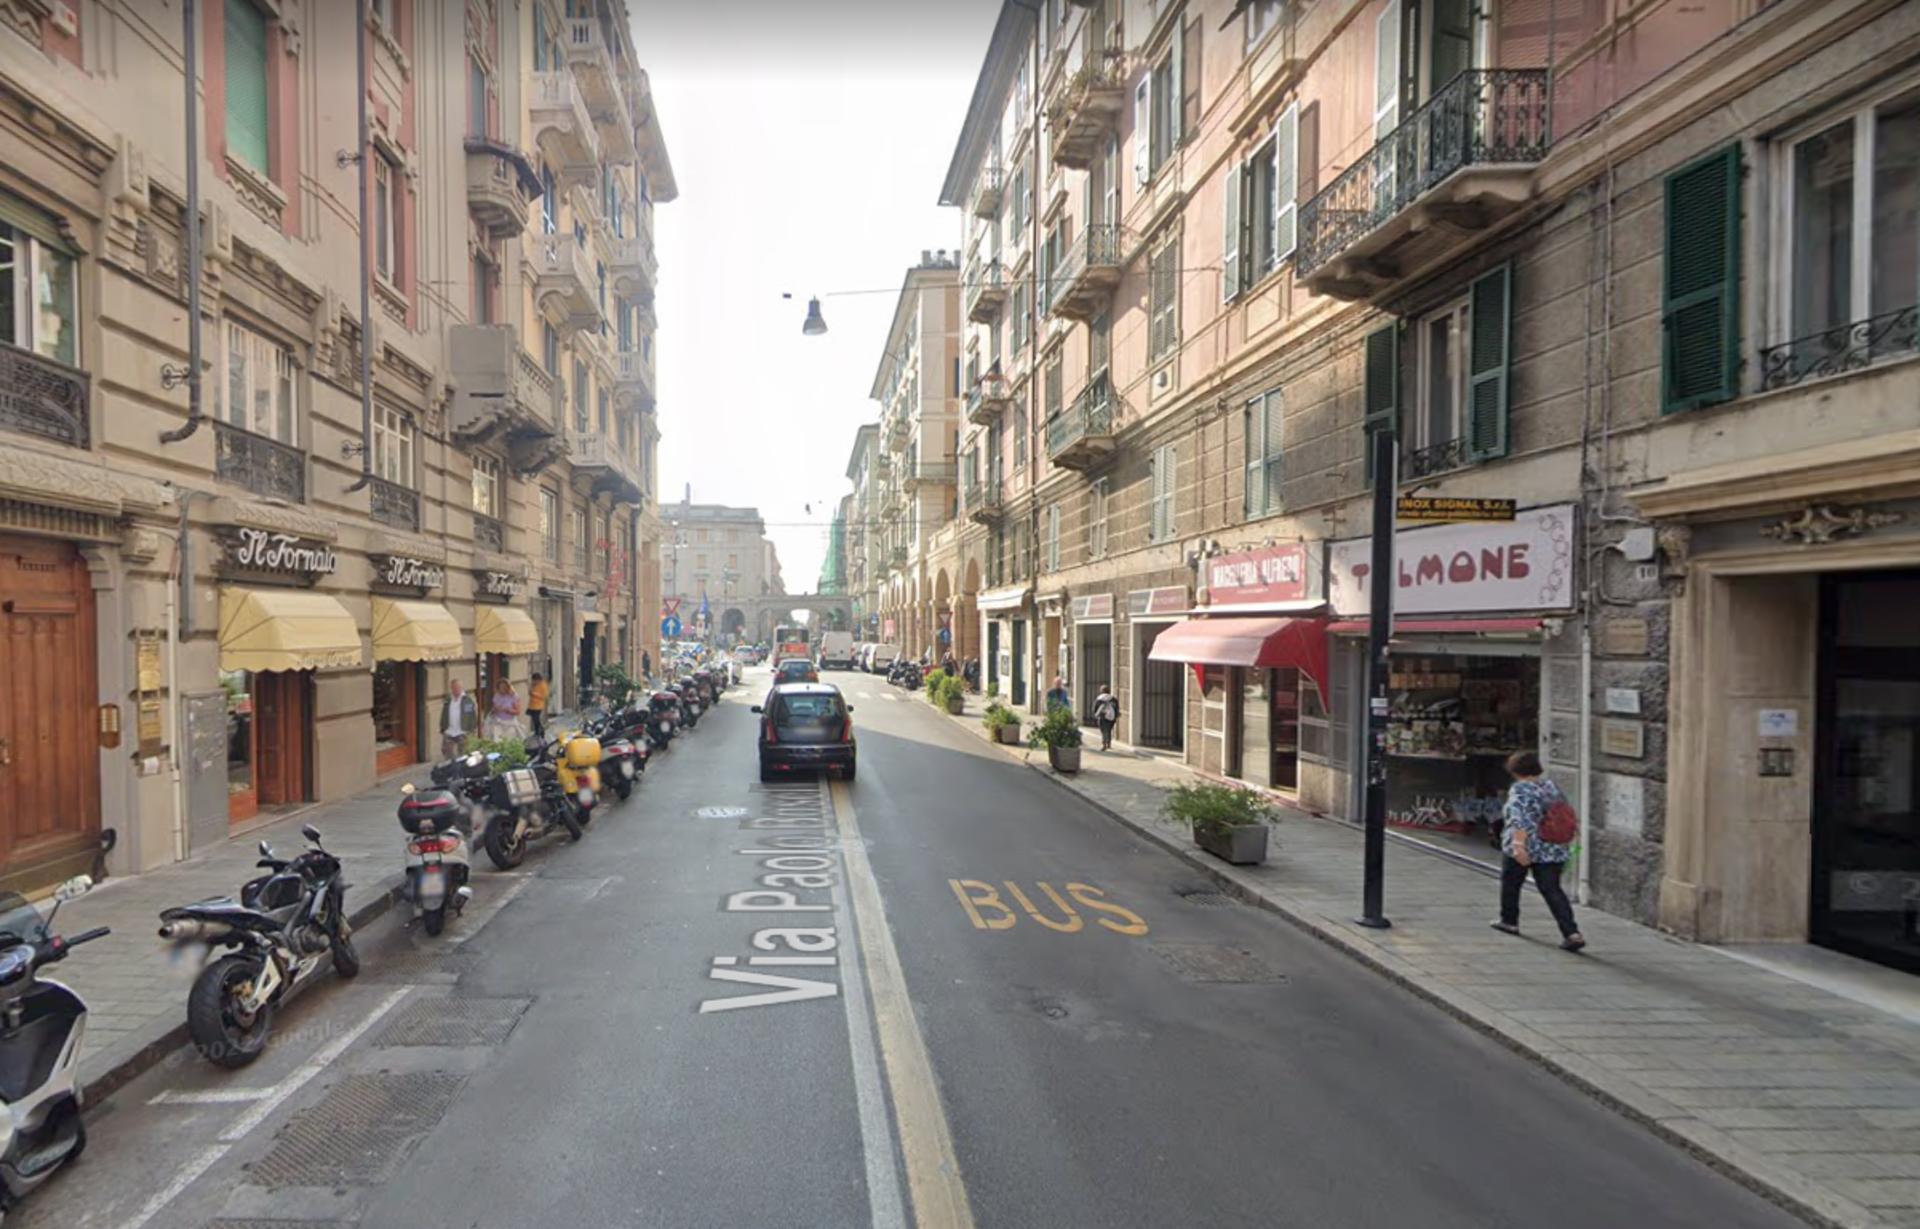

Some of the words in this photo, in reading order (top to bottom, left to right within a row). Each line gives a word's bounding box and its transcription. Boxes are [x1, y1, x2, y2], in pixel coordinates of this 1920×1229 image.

[1399, 499, 1428, 510] INOX
[1434, 499, 1479, 510] SIGNAL
[239, 527, 268, 565] Il
[266, 534, 337, 574] Fornaio
[1352, 544, 1529, 591] TLMONE
[948, 879, 1149, 936] BUS
